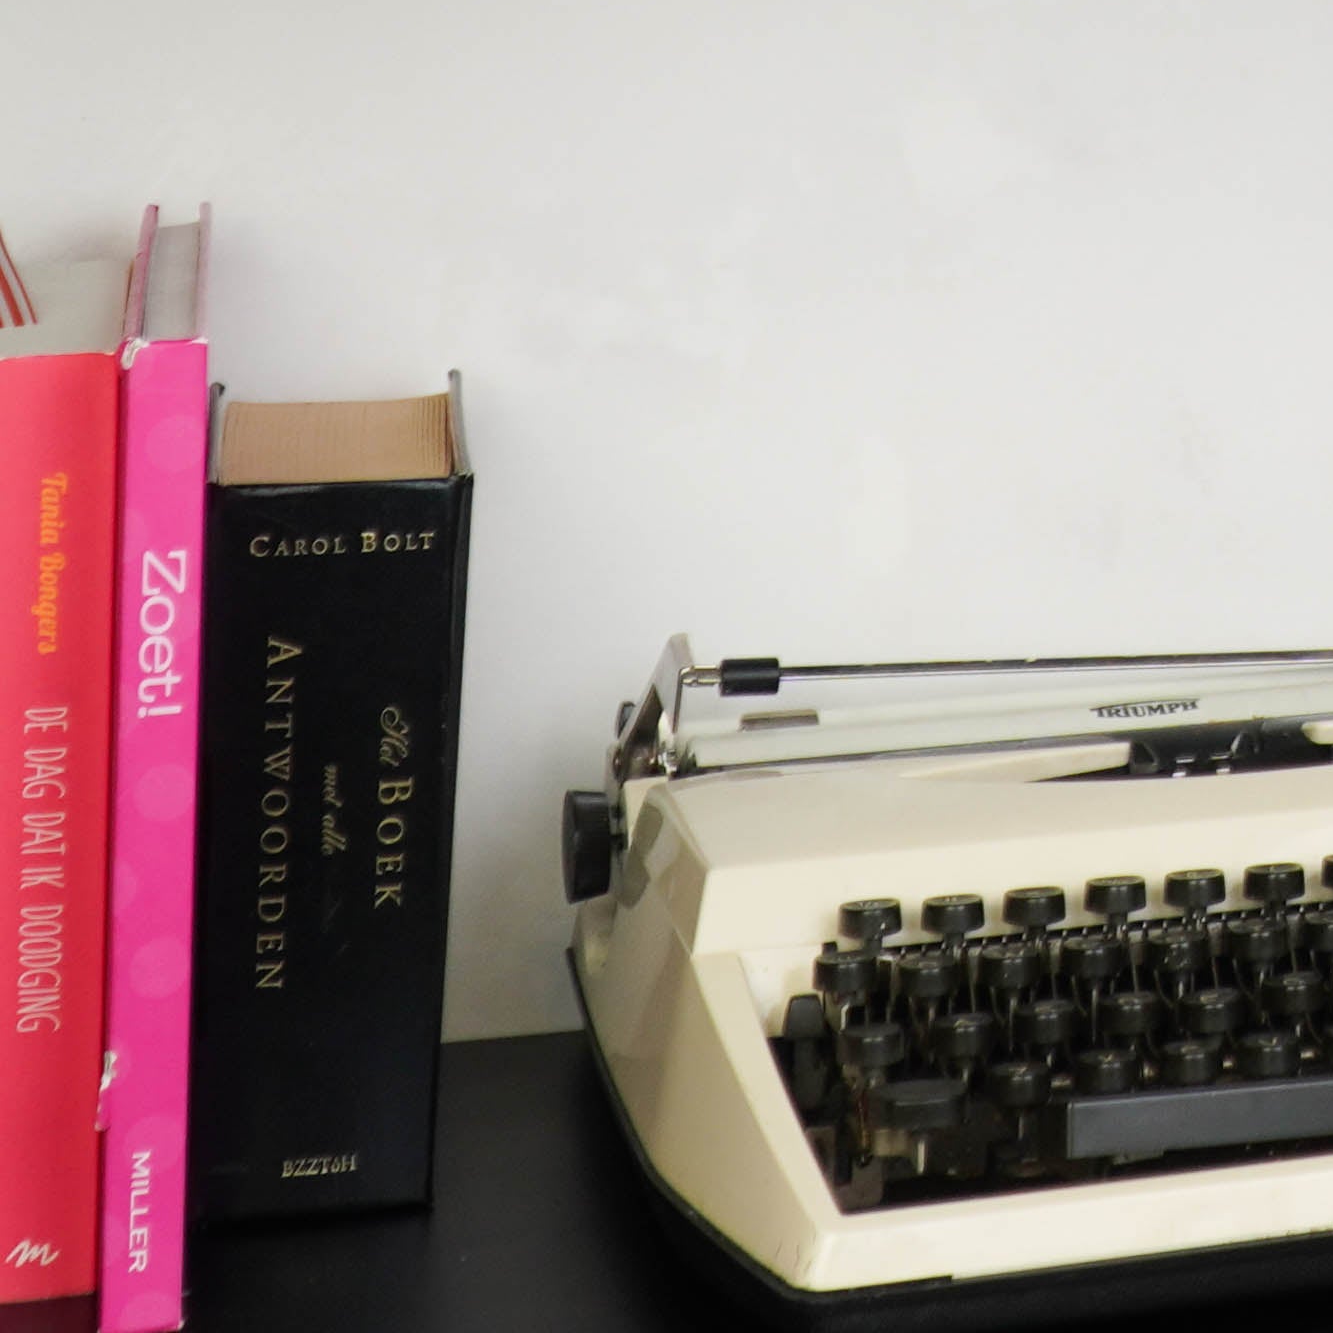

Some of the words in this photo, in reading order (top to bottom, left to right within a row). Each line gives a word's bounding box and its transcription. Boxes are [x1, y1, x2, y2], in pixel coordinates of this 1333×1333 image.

[40, 472, 68, 544] Tania
[249, 533, 347, 558] CAROL
[360, 531, 436, 554] BOLT
[31, 552, 67, 655] Bongers
[138, 549, 187, 719] Zoet!
[23, 706, 69, 734] DE
[1090, 698, 1200, 718] TRIUMPH
[22, 746, 68, 800] DAG
[20, 811, 67, 856] DAT
[255, 635, 303, 990] ANTWOORDEN
[320, 814, 347, 856] alle
[374, 776, 414, 910] BOEK
[20, 866, 66, 890] IK
[16, 903, 64, 1034] DOODGING
[128, 1148, 152, 1274] MILLER
